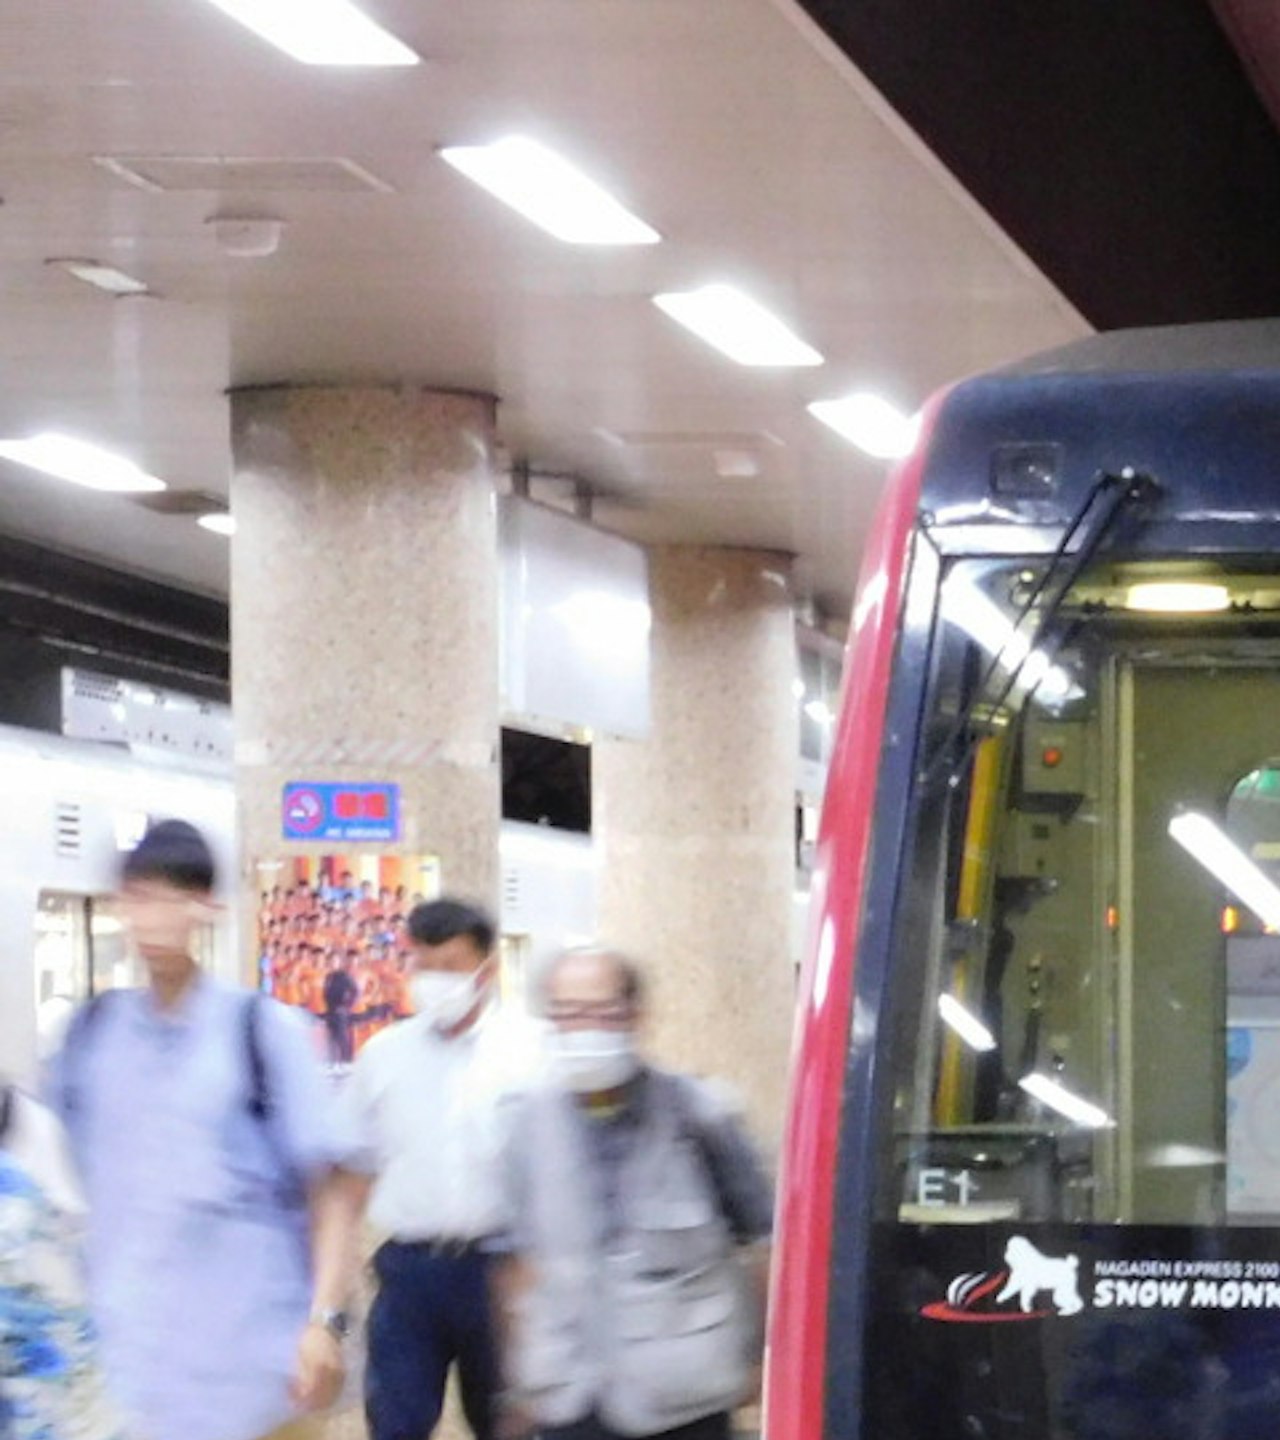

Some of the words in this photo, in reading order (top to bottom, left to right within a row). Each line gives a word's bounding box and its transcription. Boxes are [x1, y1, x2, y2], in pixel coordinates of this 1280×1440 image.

[919, 1168, 969, 1207] E1
[1095, 1260, 1171, 1276] NAGADEN
[1173, 1261, 1242, 1277] EXPRESS
[1244, 1262, 1280, 1278] 2100
[1093, 1279, 1188, 1308] SNOW
